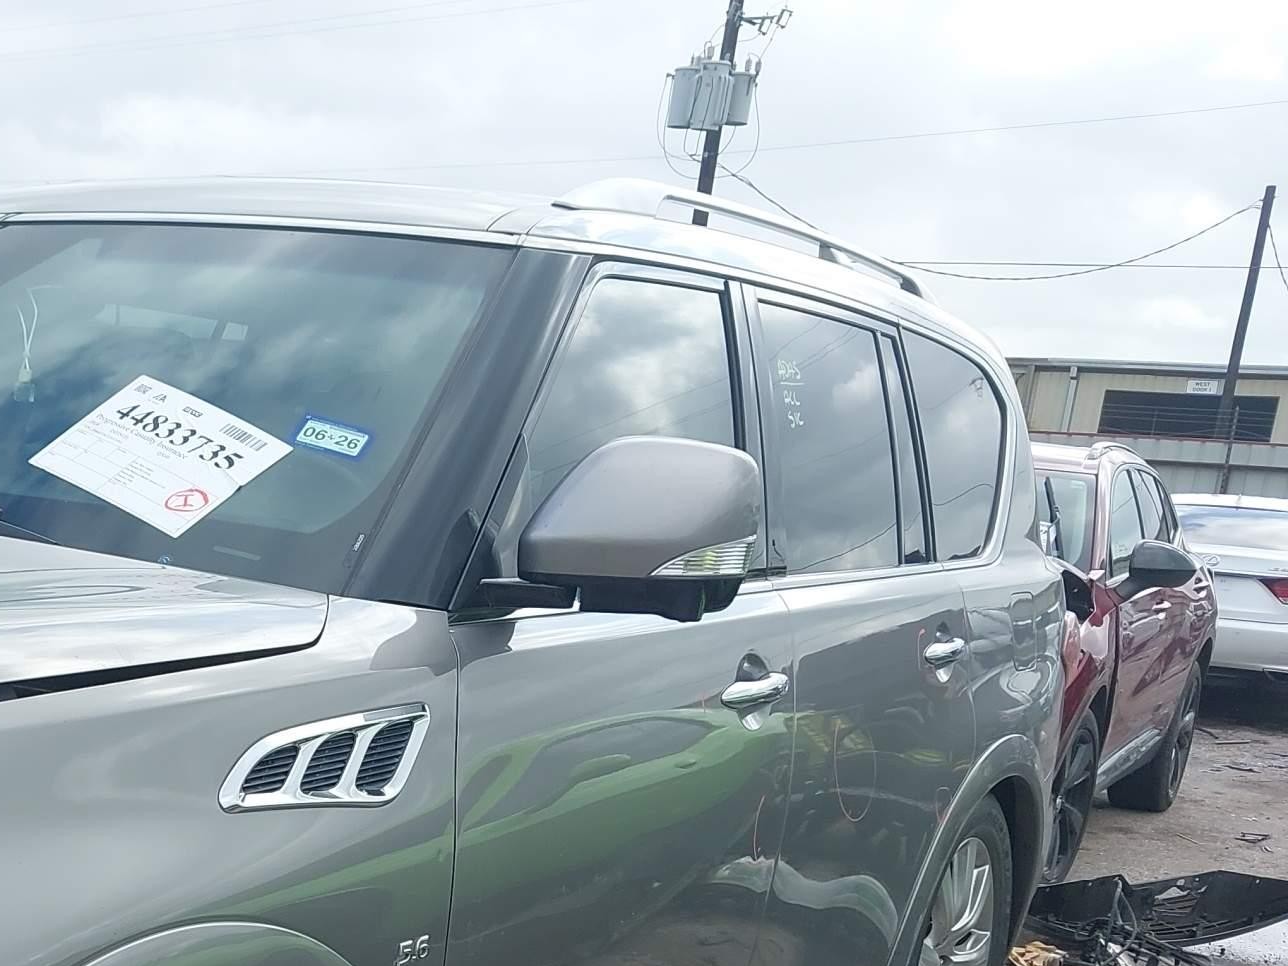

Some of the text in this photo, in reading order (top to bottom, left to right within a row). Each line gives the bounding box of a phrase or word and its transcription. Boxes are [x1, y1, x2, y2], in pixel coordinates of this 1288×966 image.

[116, 404, 245, 470] 44833735
[303, 426, 328, 441] 06
[334, 434, 361, 450] 26
[395, 934, 430, 966] 5.6
